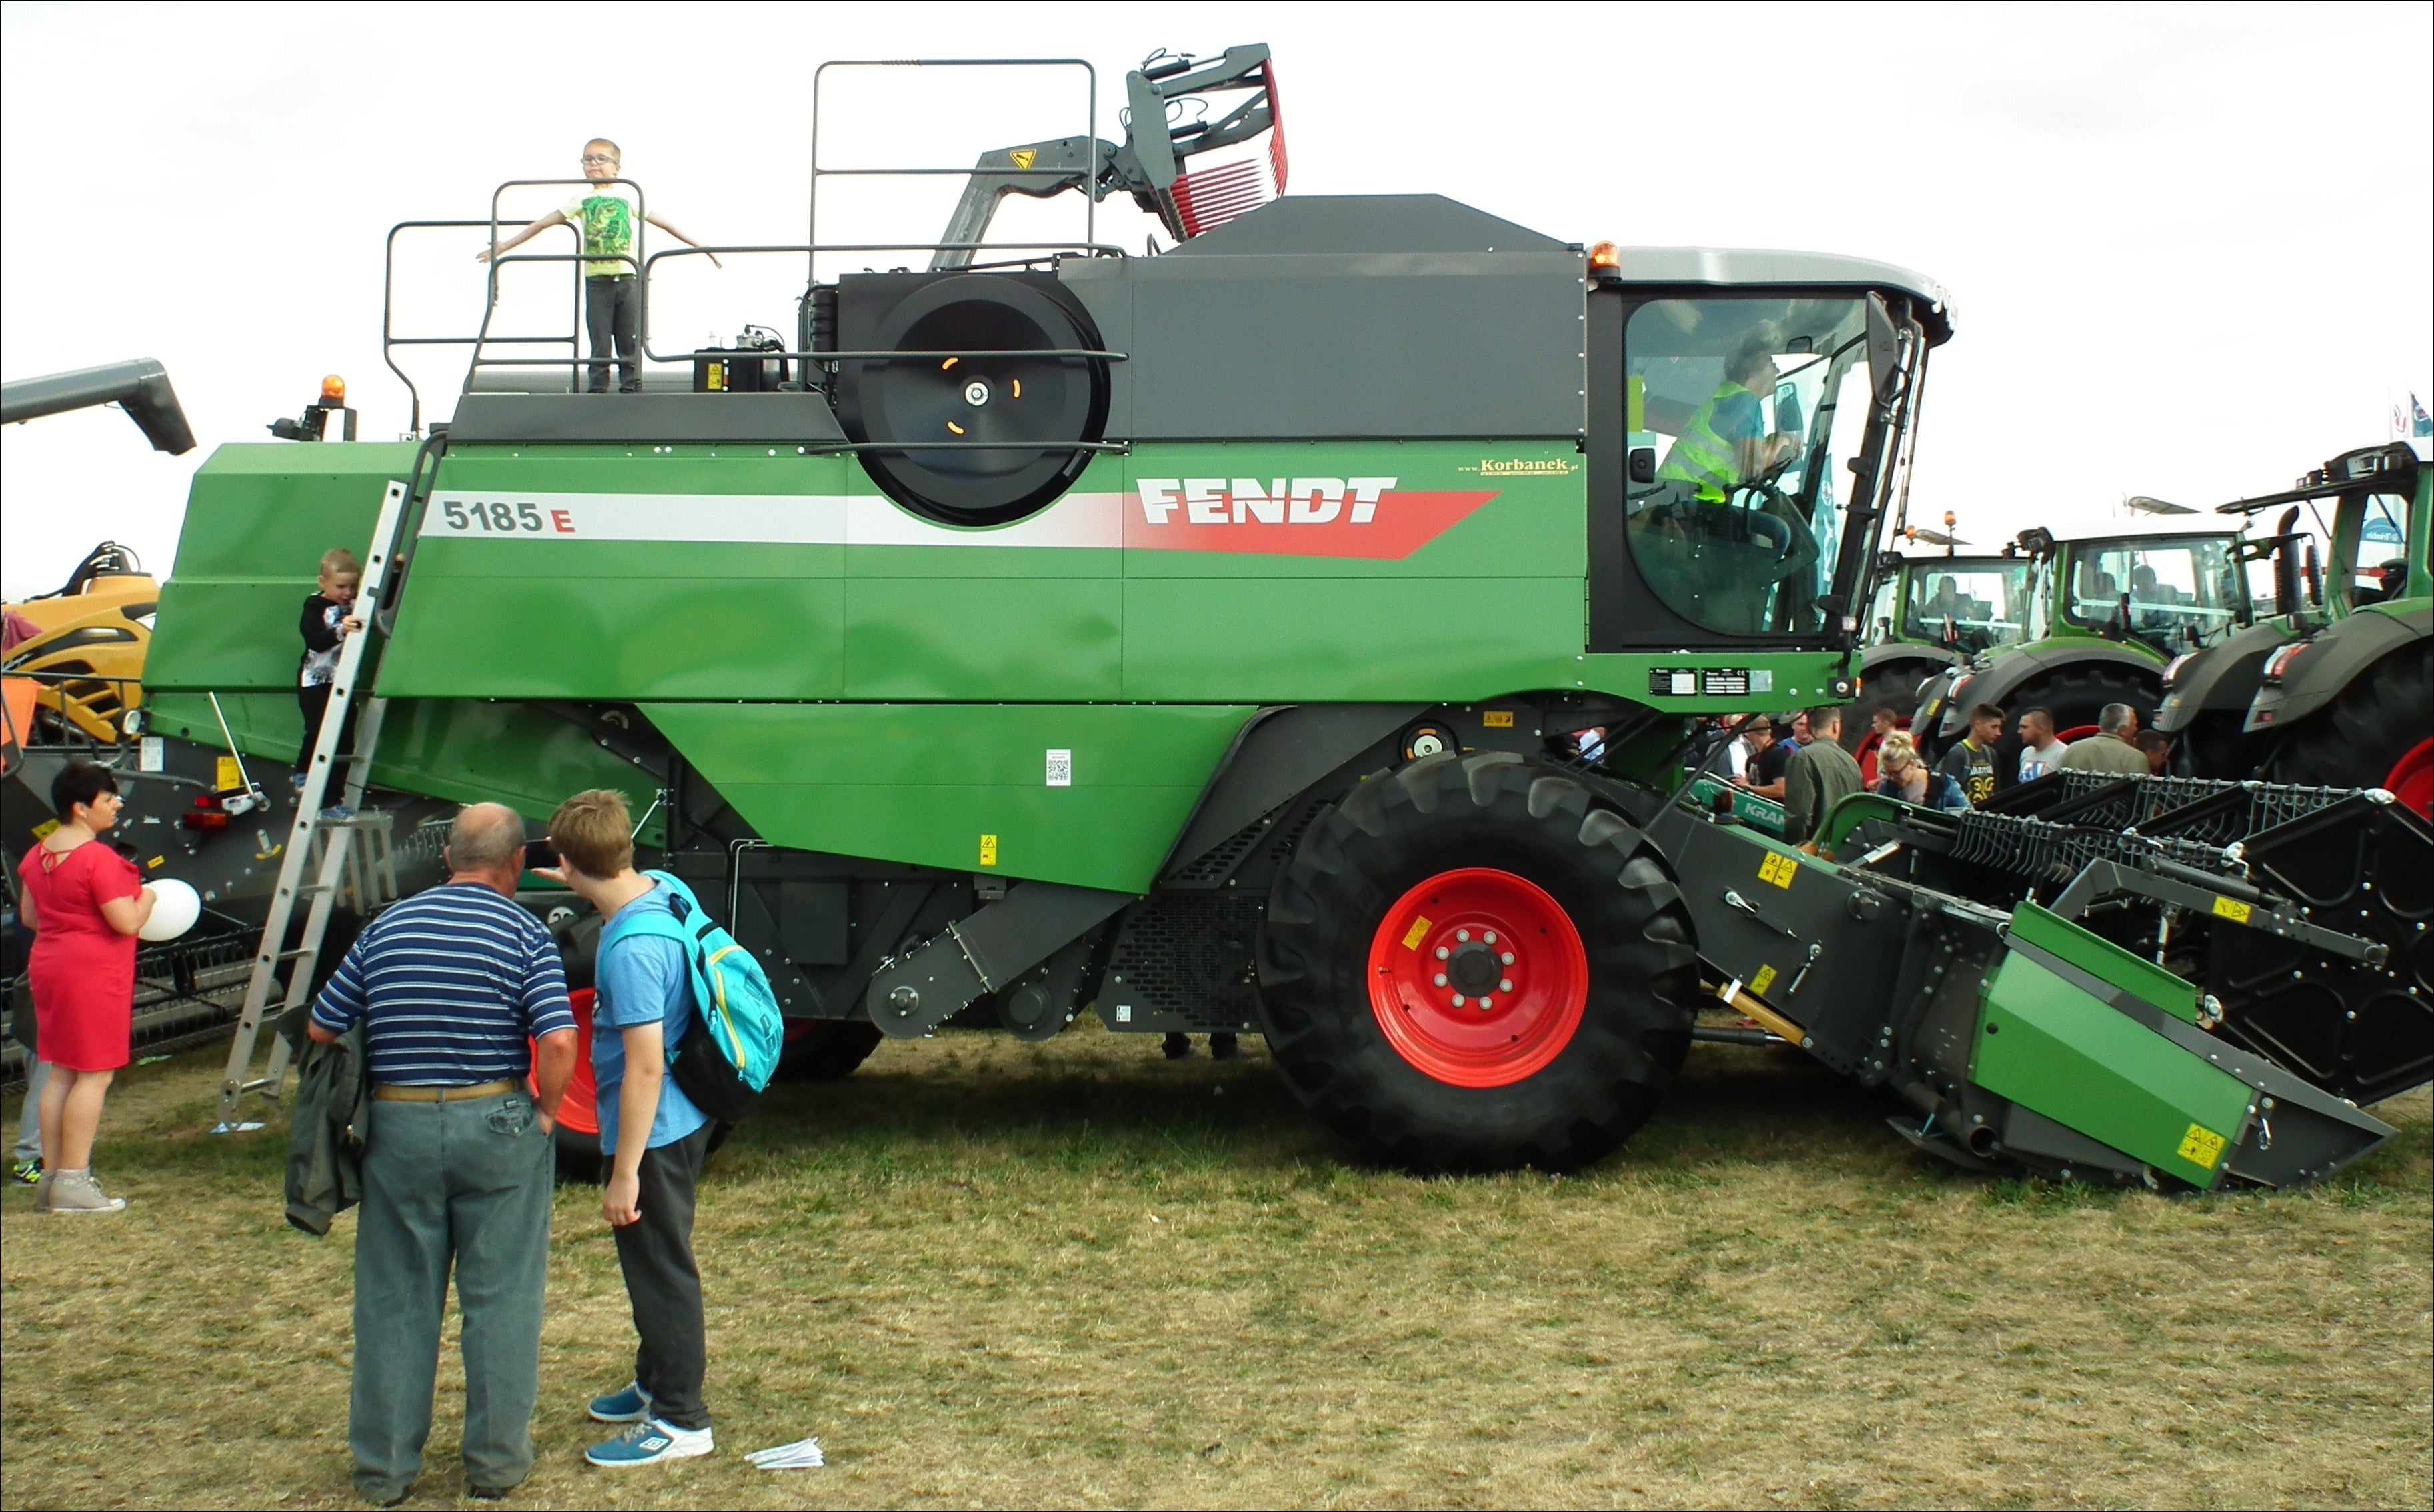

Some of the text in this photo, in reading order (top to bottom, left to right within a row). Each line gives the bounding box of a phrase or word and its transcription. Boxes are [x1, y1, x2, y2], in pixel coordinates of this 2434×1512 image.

[1458, 458, 1578, 471] www.Korbanek.pl
[1136, 477, 1398, 524] FENDT
[443, 501, 576, 533] 5185 E
